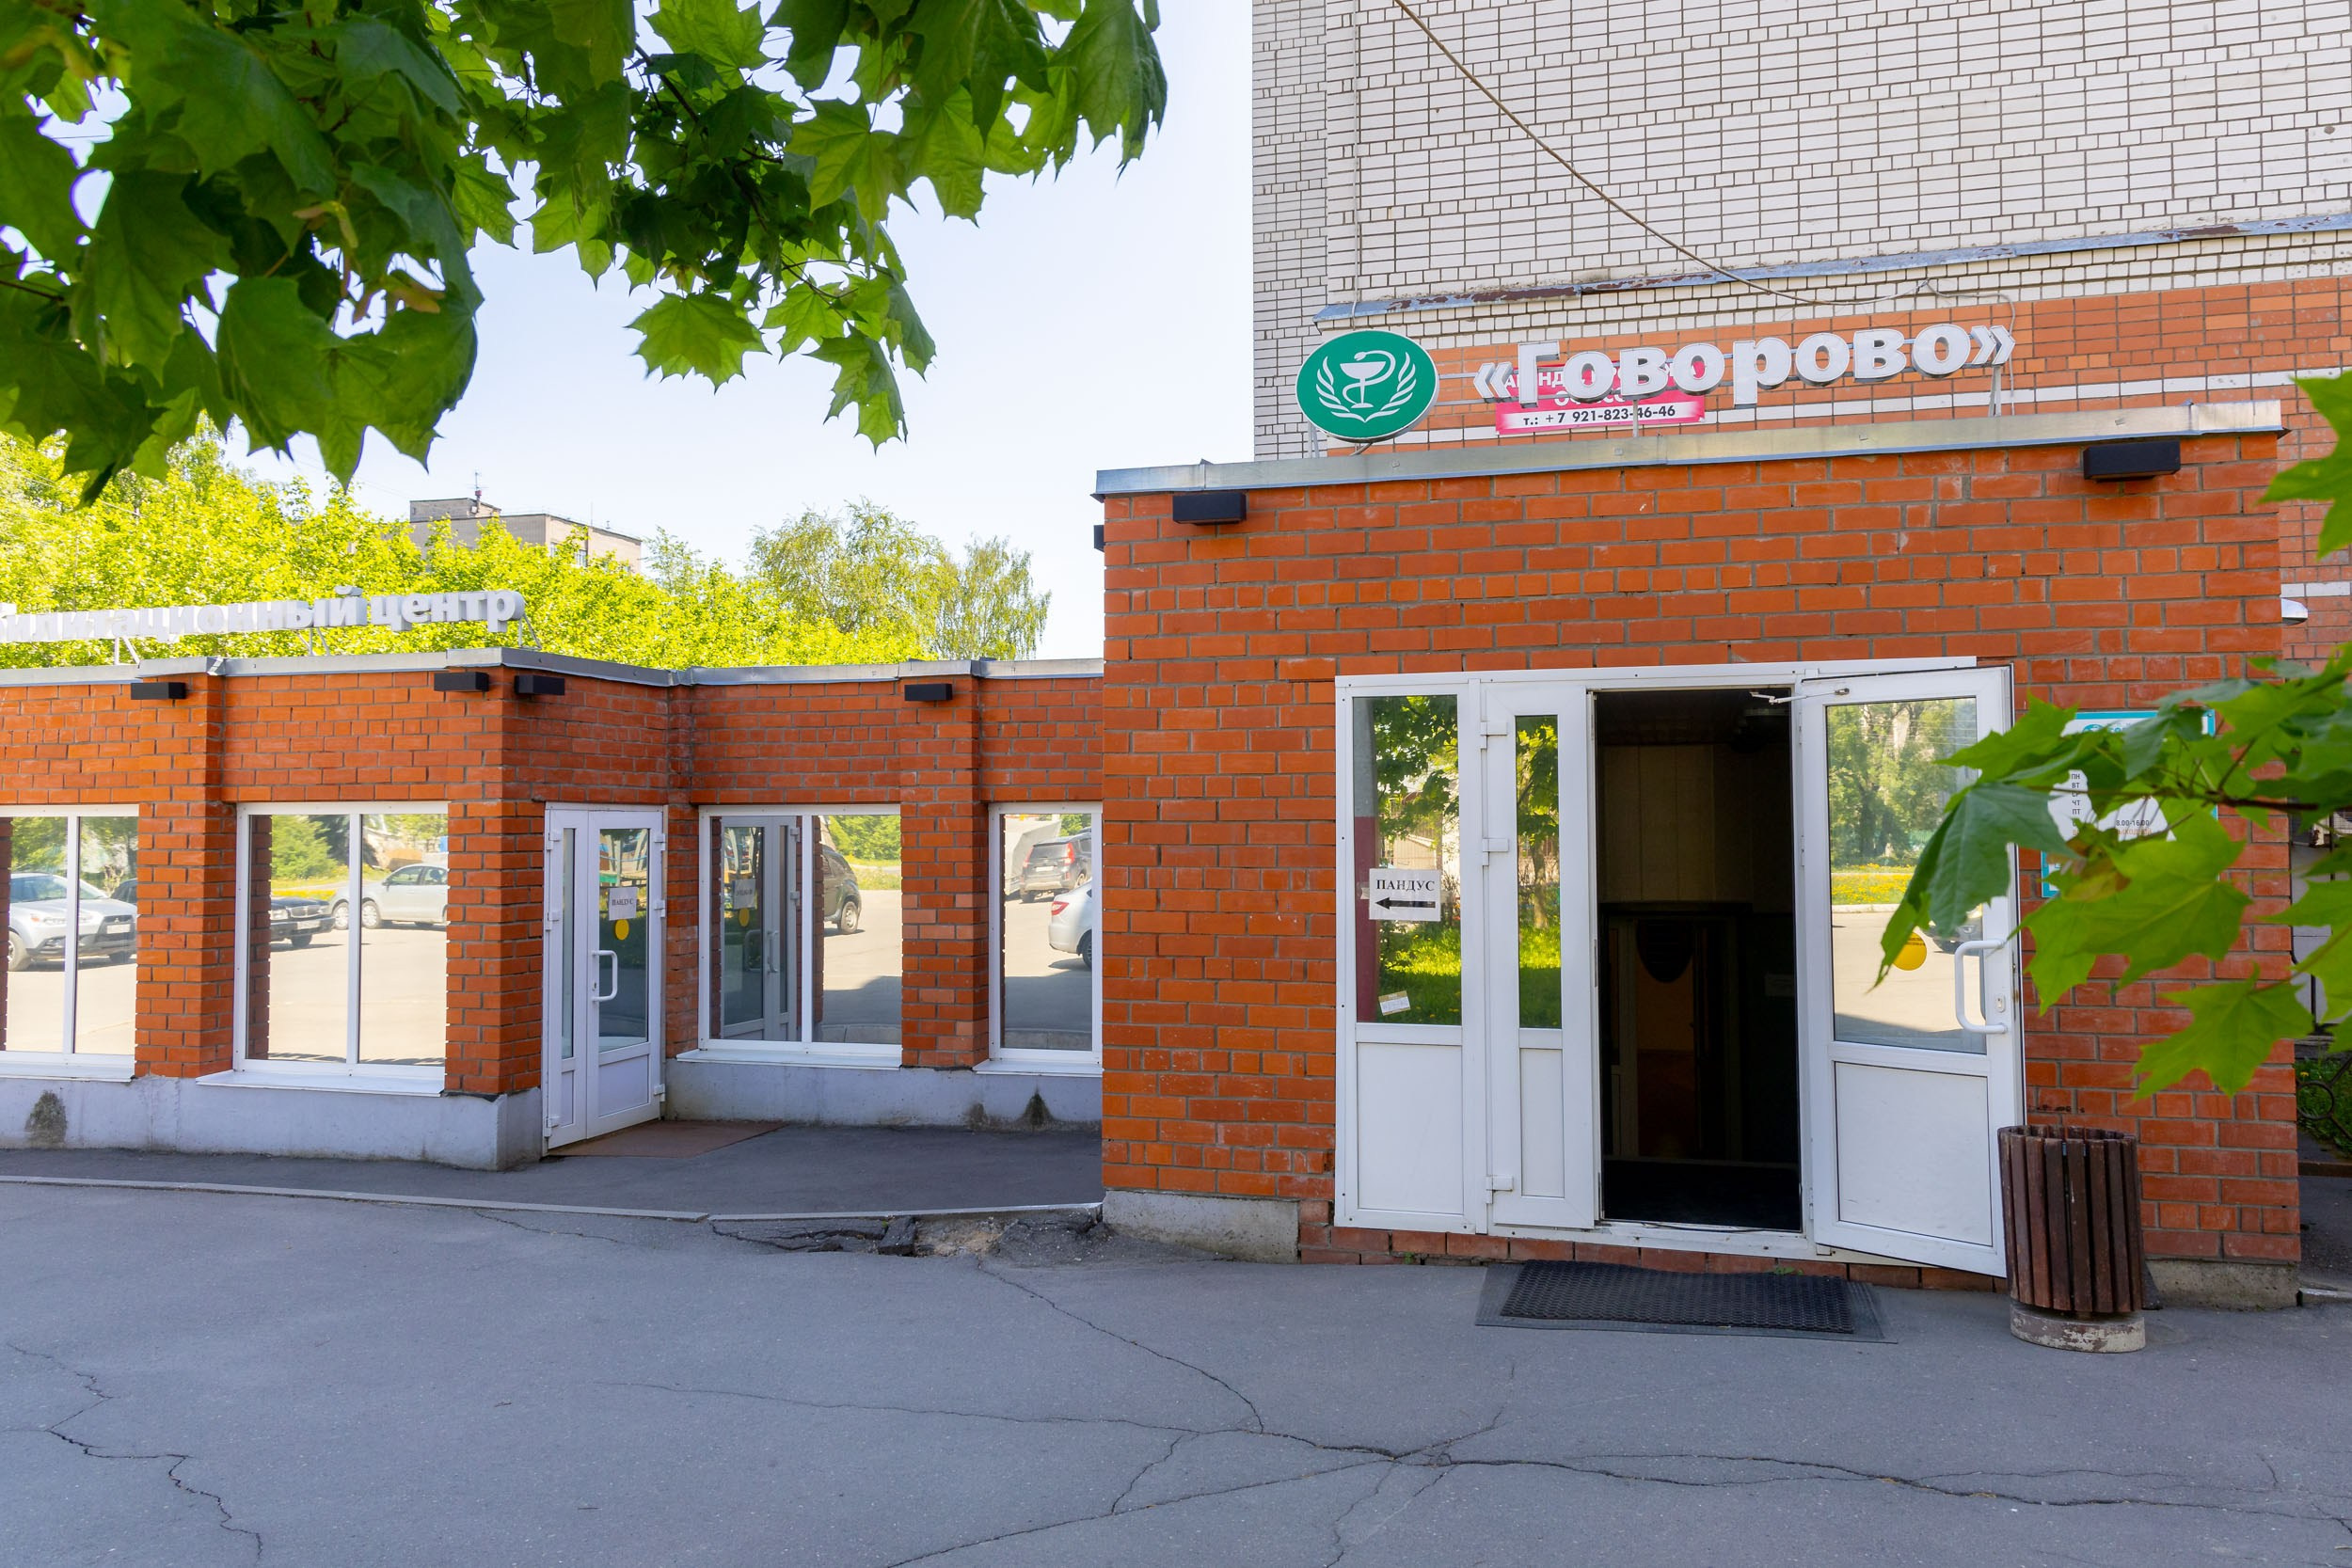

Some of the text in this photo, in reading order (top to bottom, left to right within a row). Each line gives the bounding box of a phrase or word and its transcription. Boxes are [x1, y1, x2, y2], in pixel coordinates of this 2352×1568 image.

[1473, 324, 2016, 408] «Говорово»
[1572, 404, 1677, 422] 921-823-46-46
[370, 590, 525, 633] центр
[1376, 879, 1436, 892] ПАНДУС
